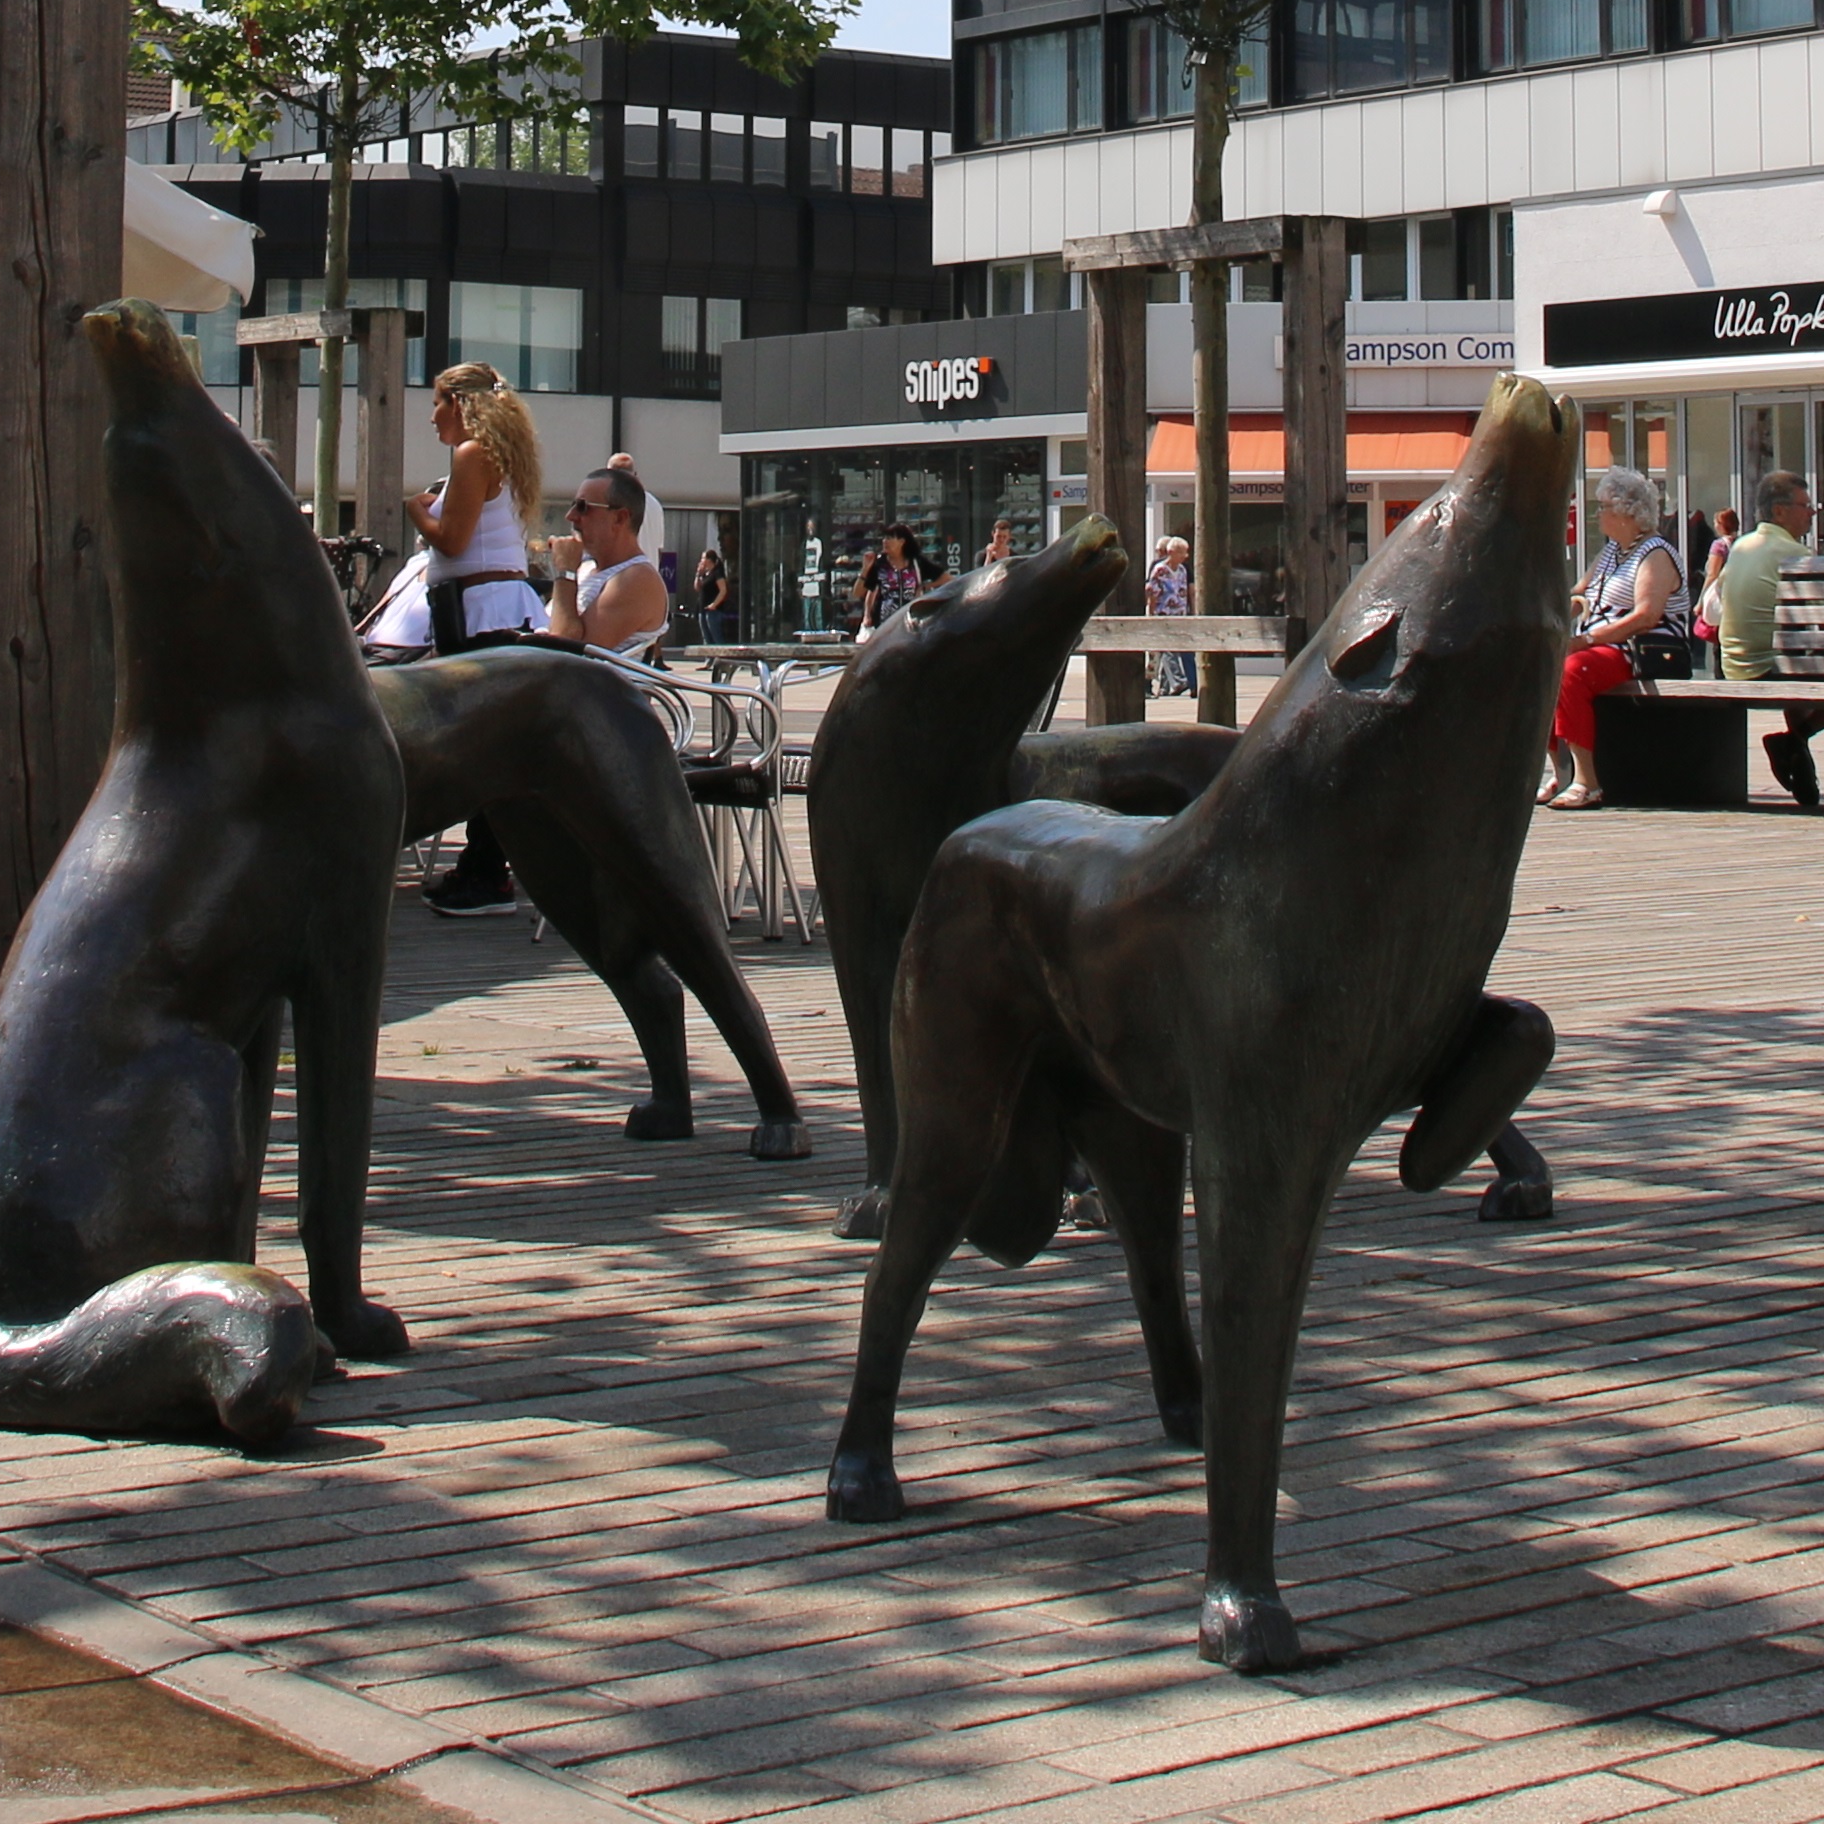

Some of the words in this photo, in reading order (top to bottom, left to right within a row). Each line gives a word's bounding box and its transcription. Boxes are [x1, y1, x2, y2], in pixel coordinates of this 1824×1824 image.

[1715, 296, 1766, 339] Ulla
[1346, 341, 1447, 365] ampson
[905, 357, 980, 410] snipes
[1062, 484, 1088, 499] Samp
[1229, 482, 1284, 495] Sampso
